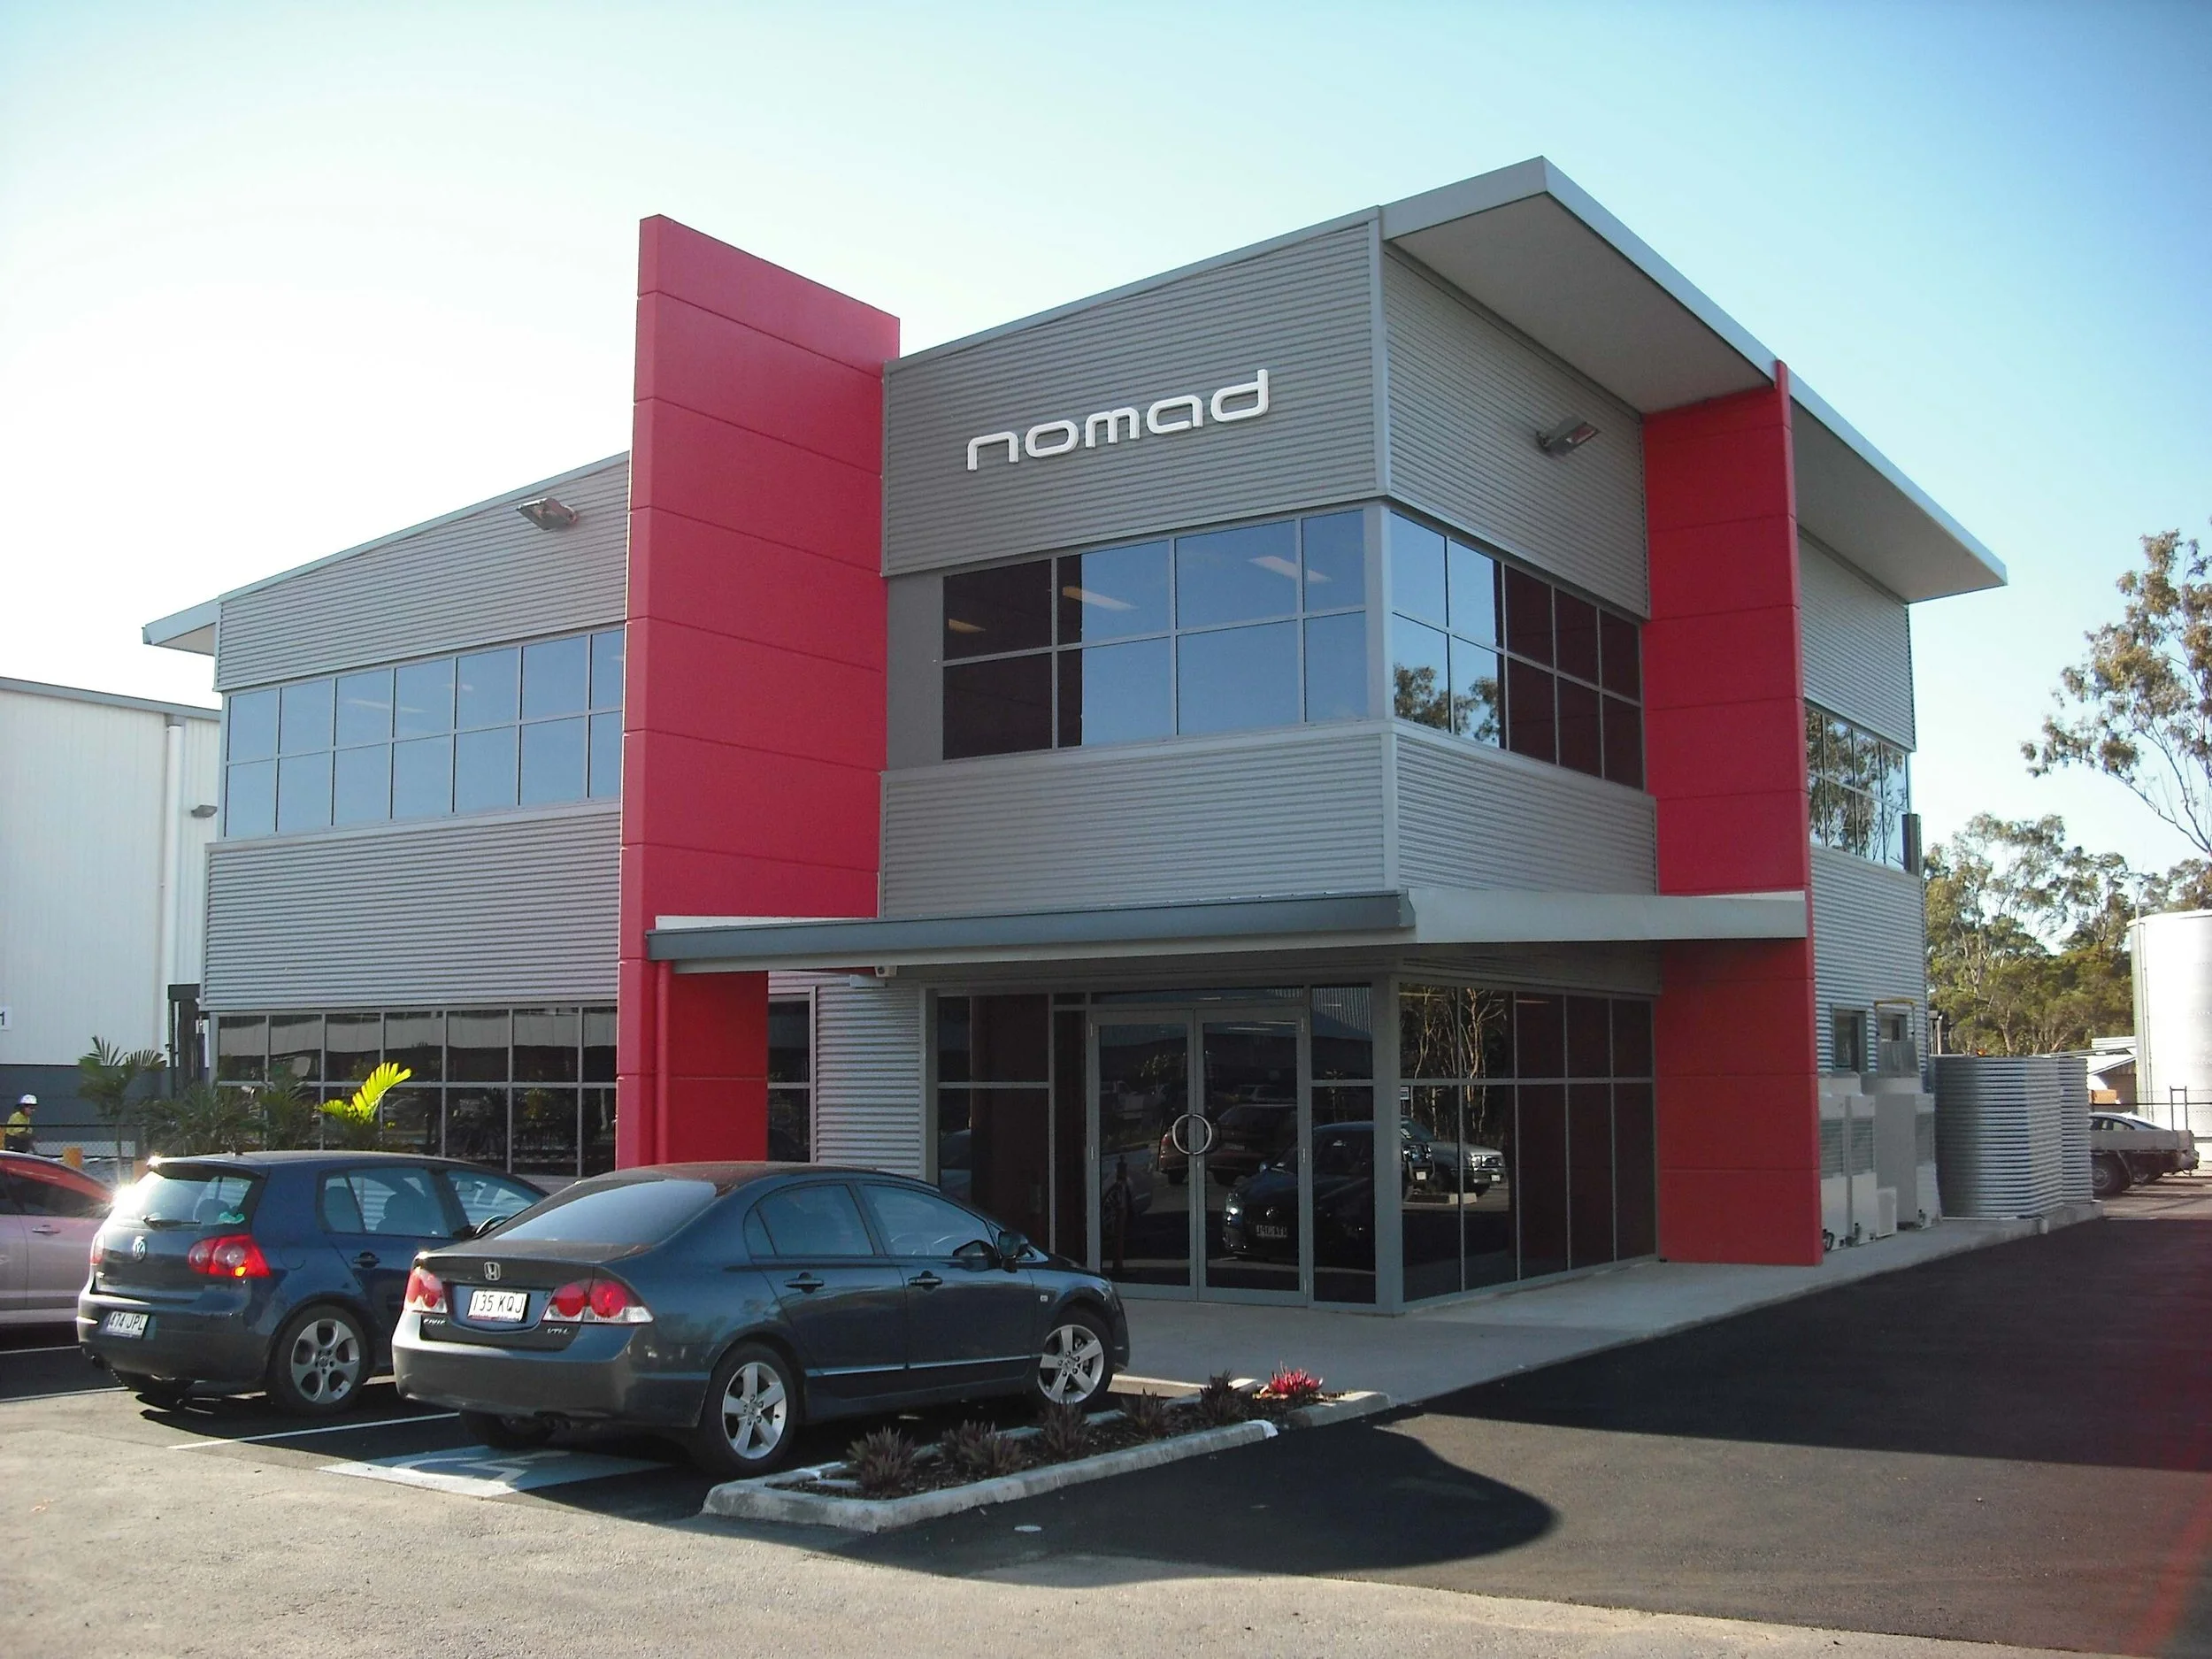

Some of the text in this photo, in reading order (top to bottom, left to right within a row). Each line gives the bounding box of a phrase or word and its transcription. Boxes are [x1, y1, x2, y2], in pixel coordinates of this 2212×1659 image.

[967, 369, 1269, 471] nomad
[473, 1294, 525, 1314] 135 KQJ
[127, 1314, 144, 1331] JPL
